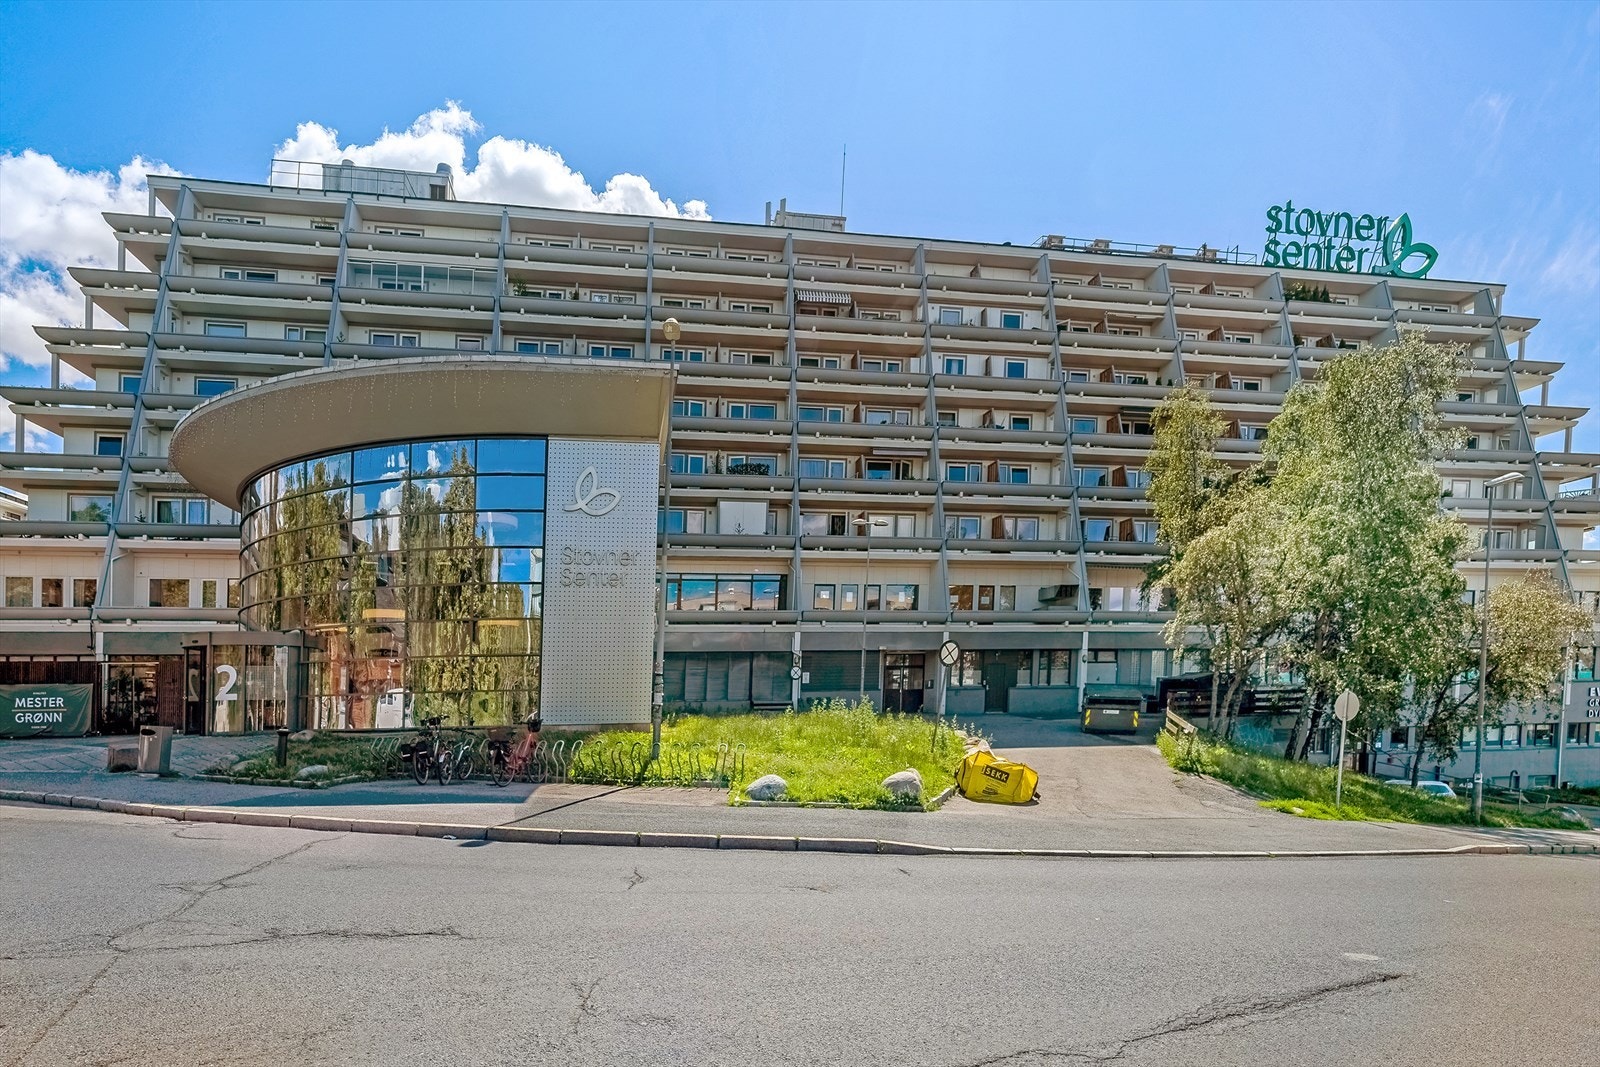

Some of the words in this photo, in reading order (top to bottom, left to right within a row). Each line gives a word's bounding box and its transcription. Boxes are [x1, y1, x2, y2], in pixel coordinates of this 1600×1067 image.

[1265, 199, 1389, 241] stovner
[1264, 237, 1370, 273] senter
[561, 546, 640, 566] Stovner
[560, 568, 629, 587] Senter
[215, 664, 238, 701] 2
[14, 697, 65, 708] MESTER
[14, 712, 63, 724] GRØNN
[1588, 709, 1600, 718] DY
